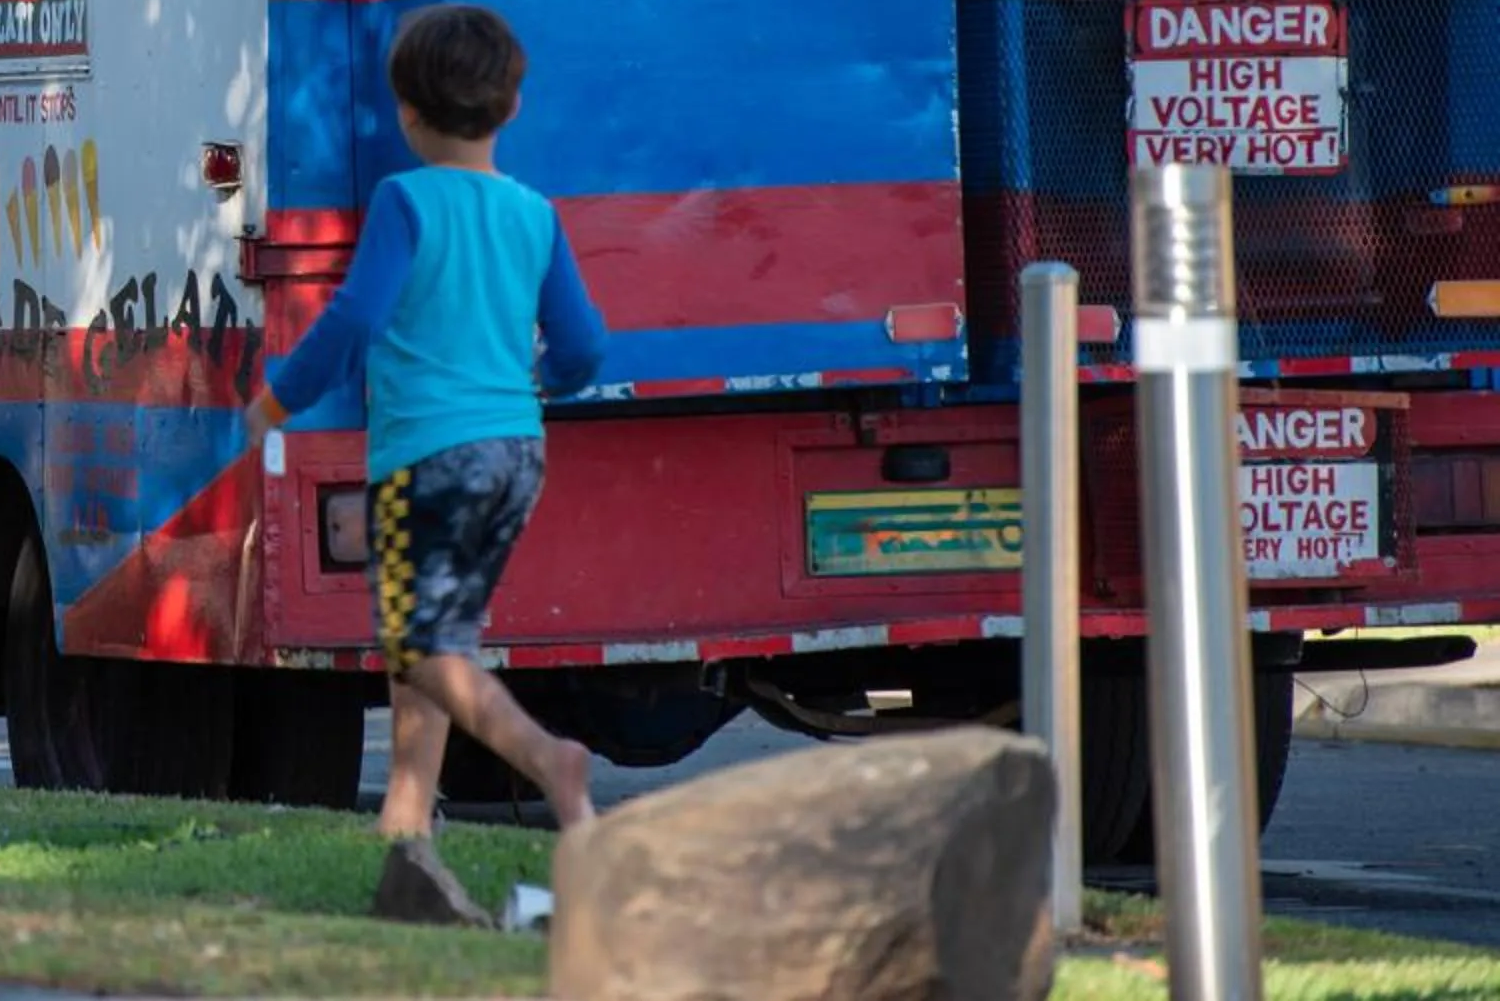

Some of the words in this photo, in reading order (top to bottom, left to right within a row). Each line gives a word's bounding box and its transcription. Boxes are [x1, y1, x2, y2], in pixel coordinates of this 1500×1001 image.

[39, 0, 86, 44] ONLY
[1151, 5, 1329, 49] DANGER
[1189, 59, 1283, 92] HIGH
[26, 94, 37, 123] IT
[40, 91, 76, 123] STOPS
[1151, 95, 1321, 130] VOLTAGE
[1145, 136, 1236, 166] VERY
[1236, 407, 1366, 449] ANGER
[1251, 466, 1335, 496] HIGH
[1240, 500, 1369, 532] OLTAGE
[1243, 538, 1283, 562] ERY
